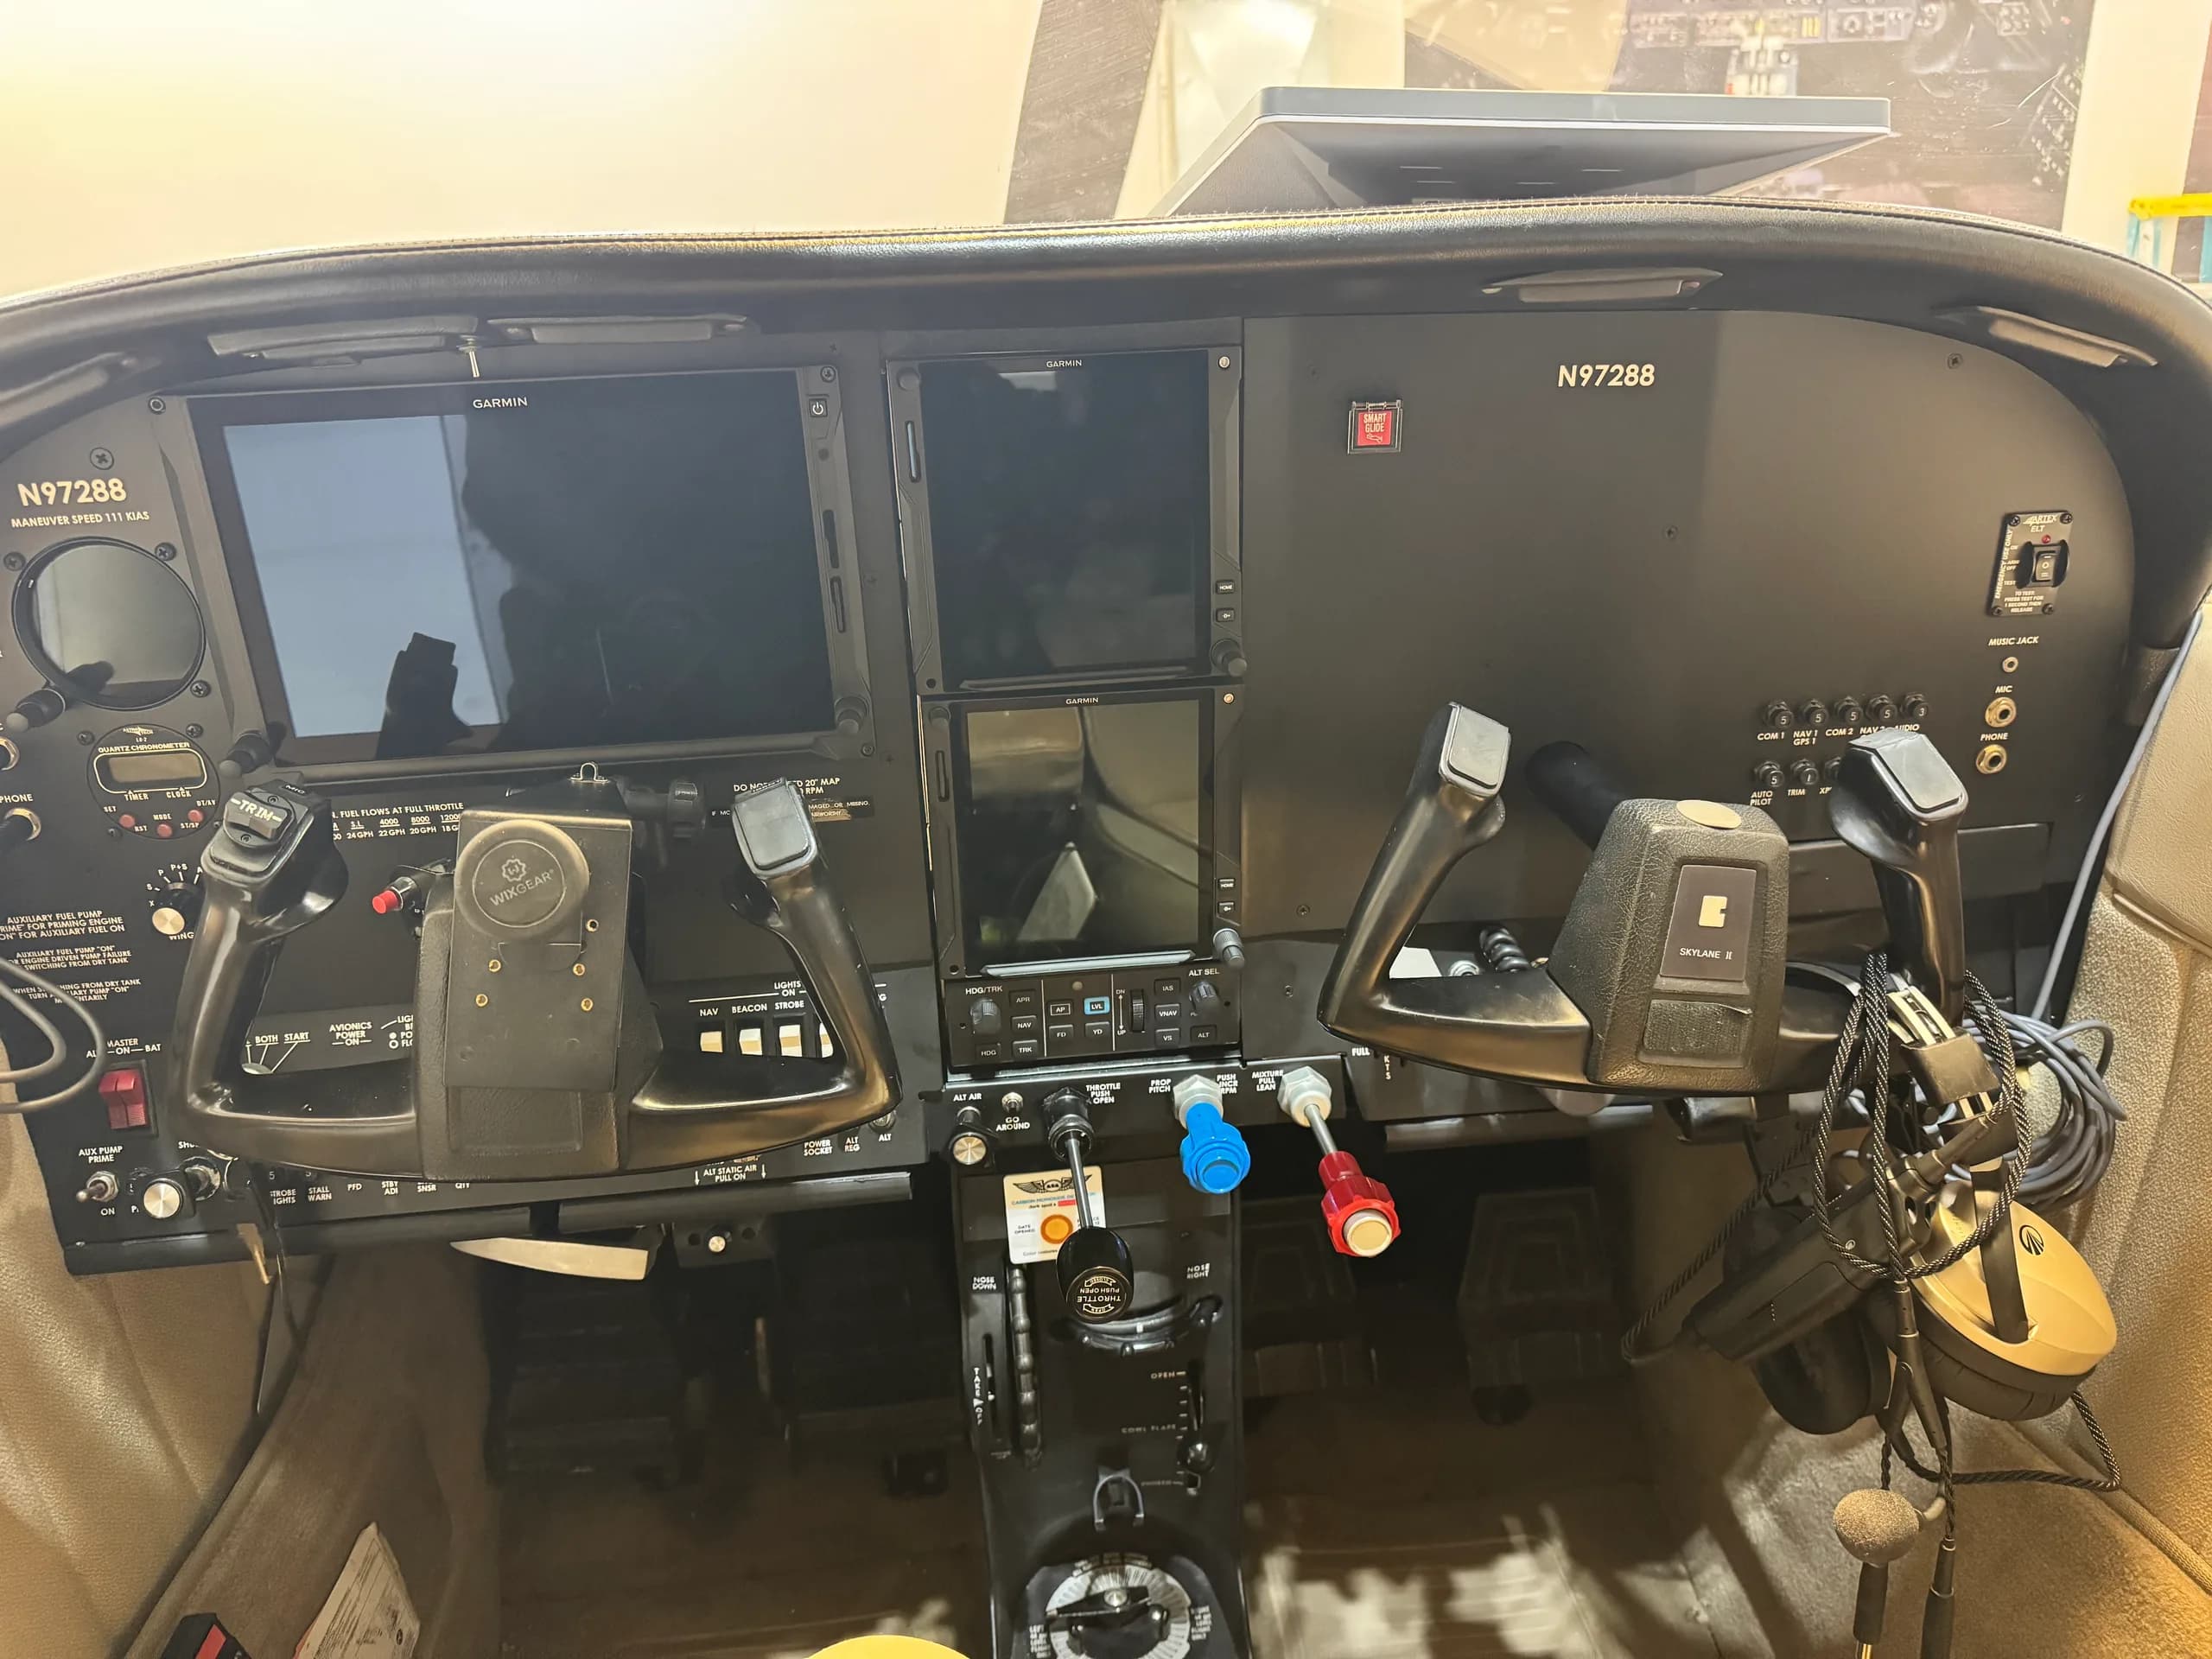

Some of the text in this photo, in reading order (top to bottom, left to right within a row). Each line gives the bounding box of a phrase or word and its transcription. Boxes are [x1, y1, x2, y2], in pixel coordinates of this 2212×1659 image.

[1046, 359, 1083, 368] GARMIN
[1557, 364, 1656, 388] N97288
[472, 397, 529, 410] GARMIN
[1363, 413, 1387, 423] SMART
[1365, 423, 1385, 433] GLIDE
[17, 478, 127, 506] N97288
[11, 511, 149, 528] MANEUVER SPEED 111 KIAS
[1988, 636, 2039, 646] MUSIC JACK
[1995, 685, 2013, 694] MIC
[1065, 696, 1099, 705] GARMIN
[1851, 712, 1857, 721] 5
[1885, 709, 1891, 718] 5
[1919, 708, 1925, 716] 3
[1815, 714, 1821, 722] 5
[1859, 726, 1878, 734] NAV
[1980, 733, 2009, 741] PHONE
[131, 742, 190, 751] CHRONOMETER
[425, 803, 463, 811] THROTTLE
[7, 910, 103, 925] AUXILIARY FUEL PUMP
[0, 917, 124, 933] RIME" FOR PRIMING ENGINE
[19, 931, 37, 939] FOR
[40, 928, 86, 938] AUXILIARY
[168, 931, 194, 941] WING
[16, 950, 54, 958] AUXILIARY
[1680, 948, 1720, 959] SKYLANE
[24, 963, 67, 971] SWITCHING
[774, 981, 801, 989] LIGHTS
[965, 986, 1002, 995] HDG/TRK
[732, 1003, 767, 1014] BEACON
[775, 1001, 804, 1010] STROBE
[699, 1008, 719, 1017] NAV
[329, 1022, 372, 1032] AVIONICS
[284, 1033, 309, 1041] START
[335, 1031, 365, 1039] POWER
[116, 1046, 130, 1055] ON
[145, 1043, 162, 1052] BAT
[1352, 1046, 1370, 1056] FULL
[1252, 1070, 1284, 1078] MIXTURE
[995, 1122, 1030, 1131] AROUND
[804, 1140, 830, 1149] POWER
[845, 1136, 858, 1145] ALT
[79, 1146, 123, 1156] AUX PUMP
[804, 1147, 832, 1156] SOCKET
[844, 1144, 861, 1153] REG
[88, 1154, 114, 1163] PRIME
[718, 1166, 742, 1175] STATIC
[308, 1185, 329, 1194] STALL
[384, 1187, 398, 1196] ADI
[308, 1192, 332, 1201] WARN
